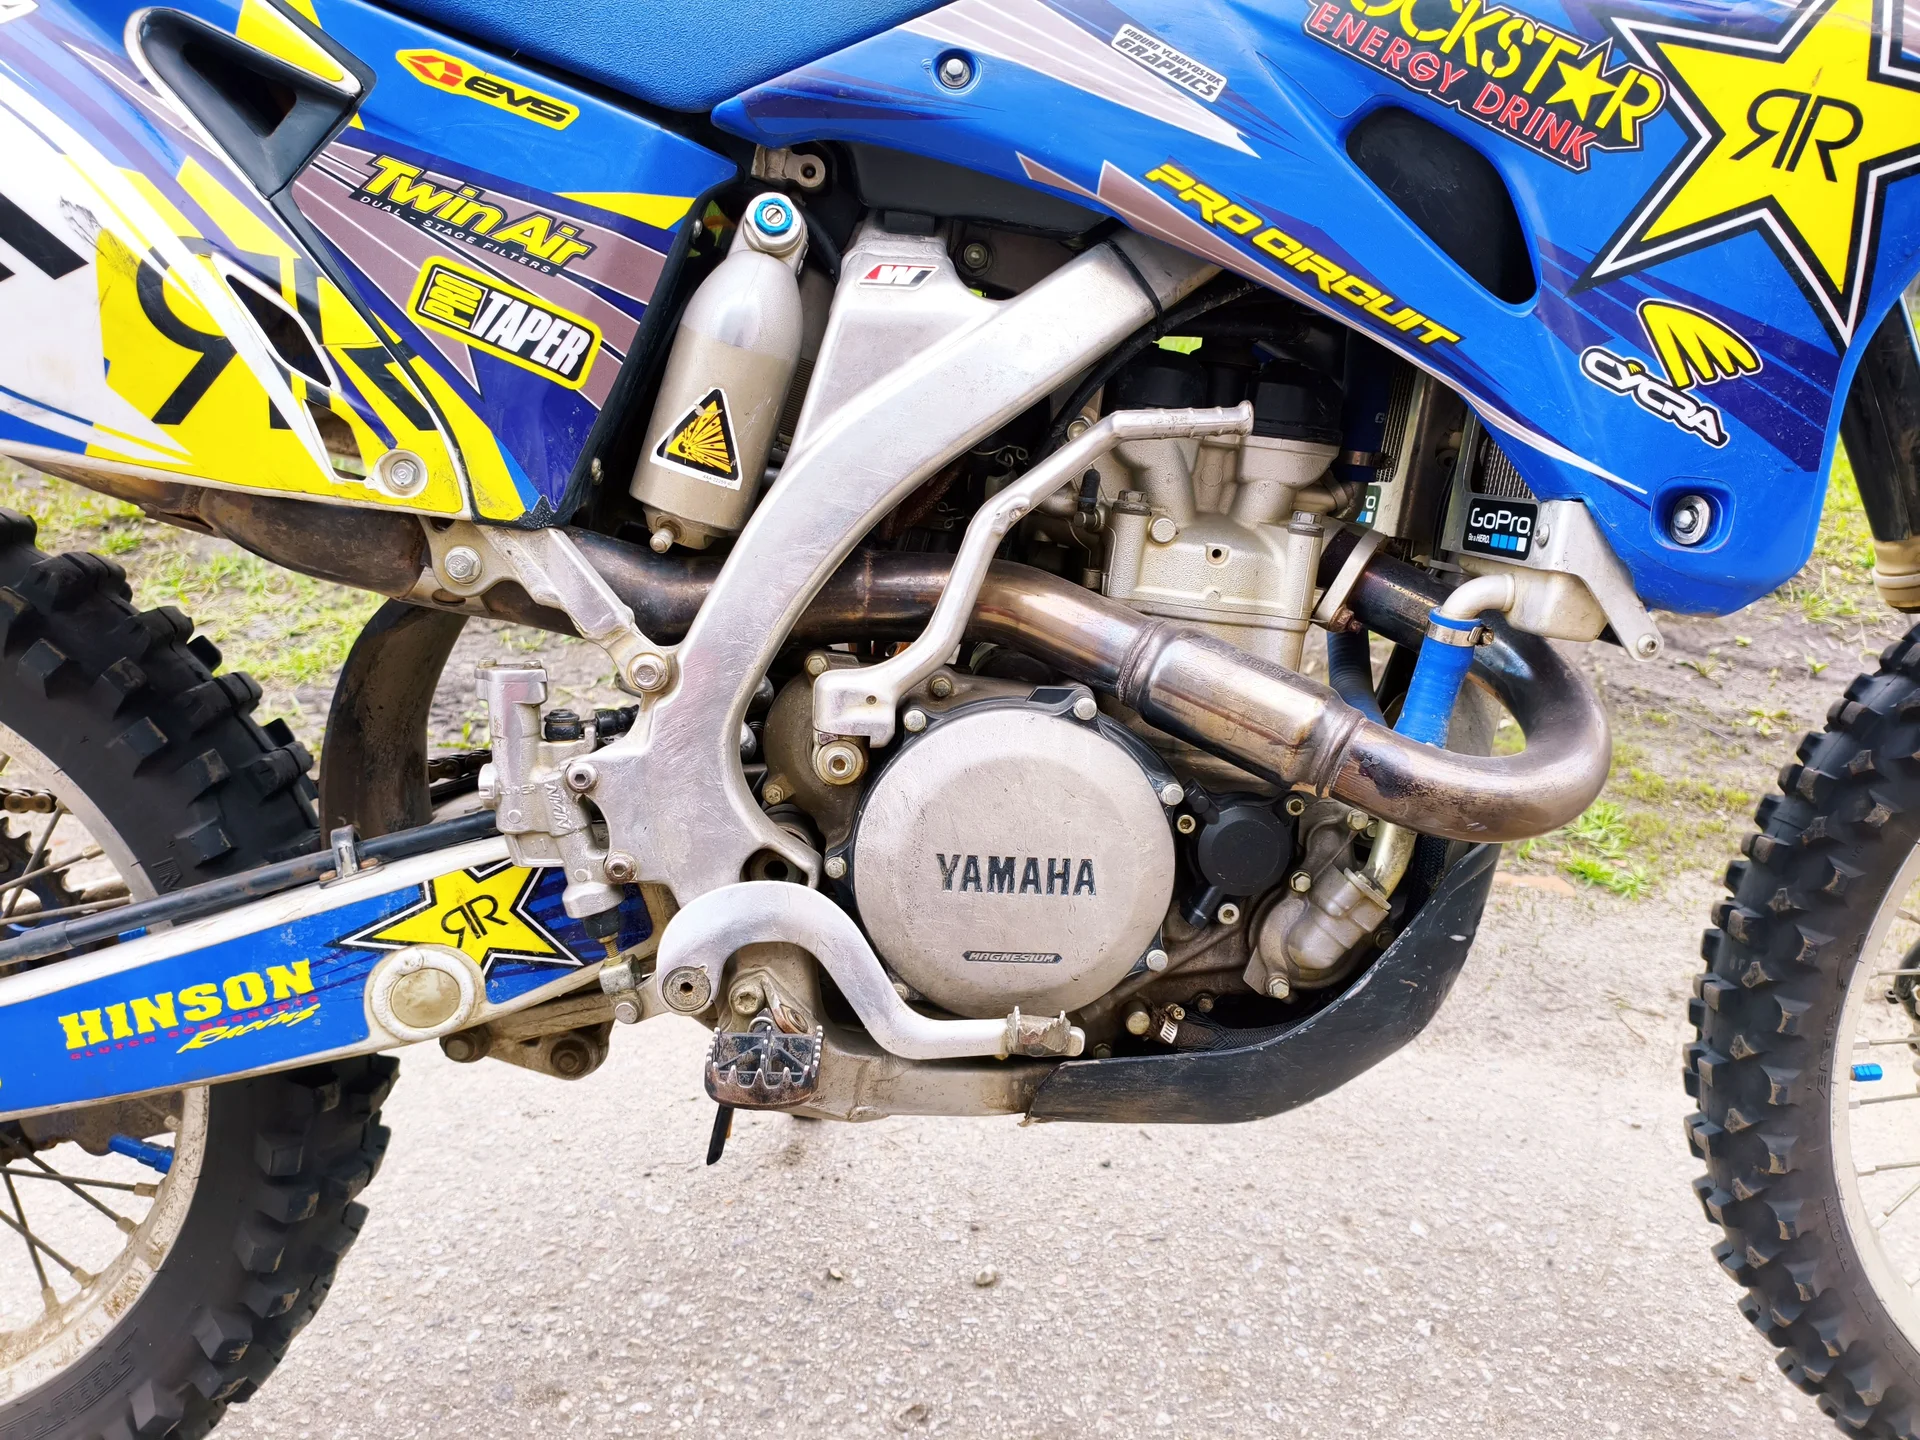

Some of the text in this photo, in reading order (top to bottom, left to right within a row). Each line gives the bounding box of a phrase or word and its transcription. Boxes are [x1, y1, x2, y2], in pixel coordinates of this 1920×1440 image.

[1115, 37, 1218, 97] GRAPHICS
[1123, 28, 1223, 86] ENDURO VLADIVOSTOK
[1309, 1, 1597, 163] ENERGY DRINK
[359, 196, 401, 216] DUAL
[421, 219, 477, 244] STAGE
[483, 242, 551, 274] FILTERS
[361, 155, 592, 266] Twin Air
[1144, 163, 1461, 345] PRO CIRCUIT
[423, 272, 591, 376] PRO TAPER
[1584, 350, 1720, 443] CYCRA
[1470, 507, 1532, 535] GoPro
[936, 853, 1097, 896] YAMAHA
[968, 952, 1056, 963] MAGNESIUM
[58, 958, 315, 1050] HINSON
